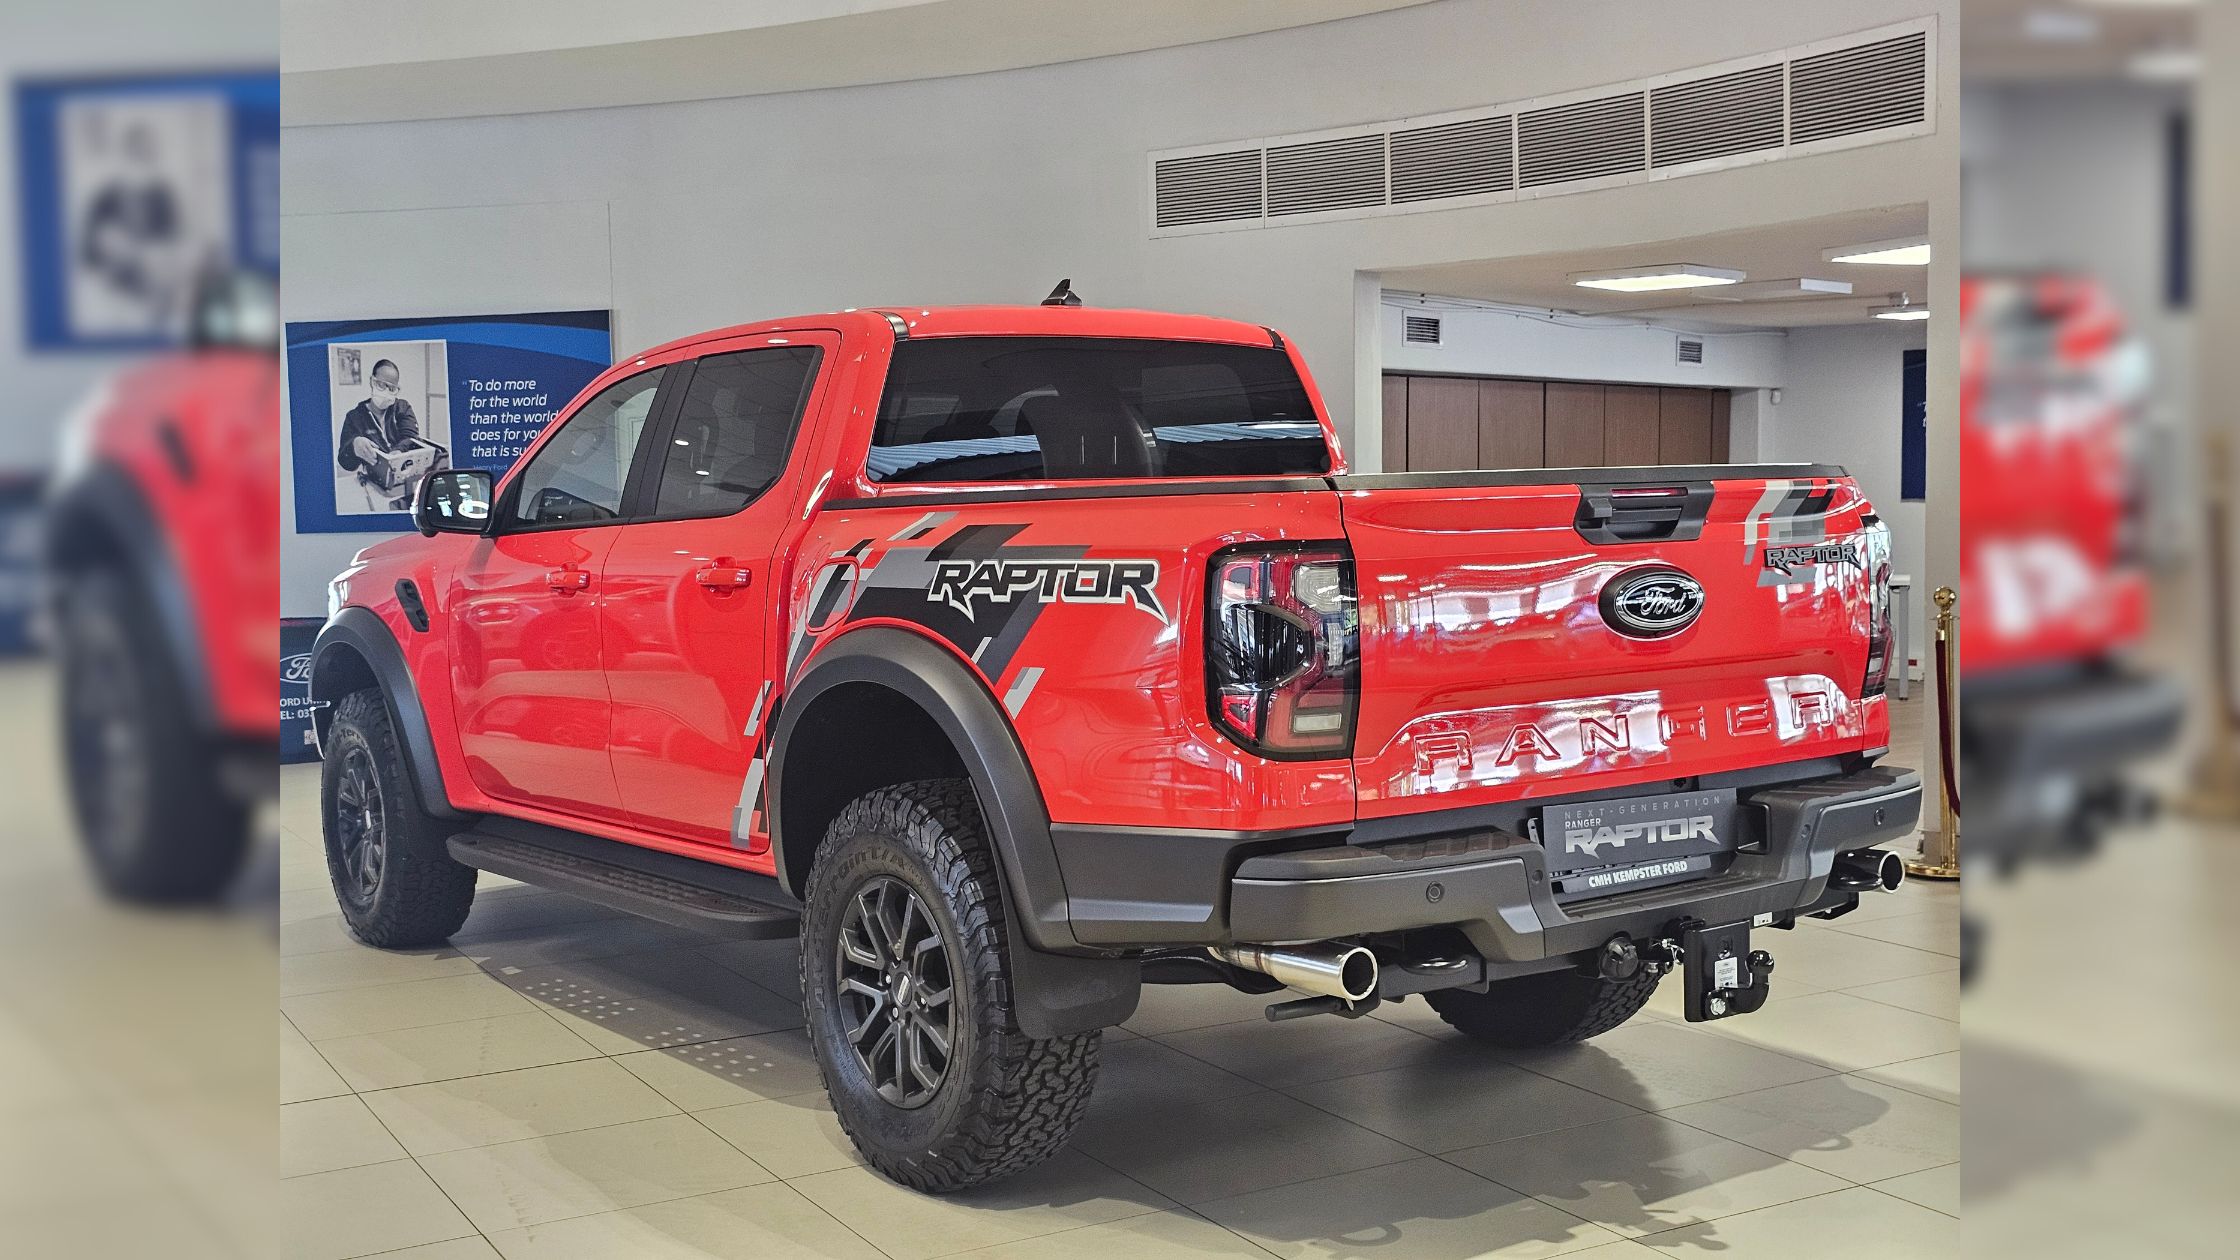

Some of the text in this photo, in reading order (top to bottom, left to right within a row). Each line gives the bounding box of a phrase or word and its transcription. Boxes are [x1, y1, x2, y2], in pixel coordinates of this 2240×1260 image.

[485, 379, 502, 391] do
[504, 380, 537, 390] more
[469, 394, 548, 410] for the world
[469, 412, 498, 425] than
[501, 412, 521, 424] the
[470, 429, 501, 441] does
[503, 428, 521, 442] for
[472, 446, 498, 457] that
[499, 445, 510, 457] is
[1764, 544, 1862, 576] RAPTOR
[927, 559, 1171, 627] RAPTOR
[1641, 586, 1686, 615] Ford
[280, 697, 301, 707] ORD
[280, 710, 295, 720] EL:
[1413, 691, 1835, 776] RANGER
[1565, 796, 1721, 819] NEXT-GENERATION
[1565, 817, 1602, 830] RANGER
[1565, 815, 1721, 860] RAPTOR
[1588, 861, 1688, 888] CMH KEMPSTER FORD
